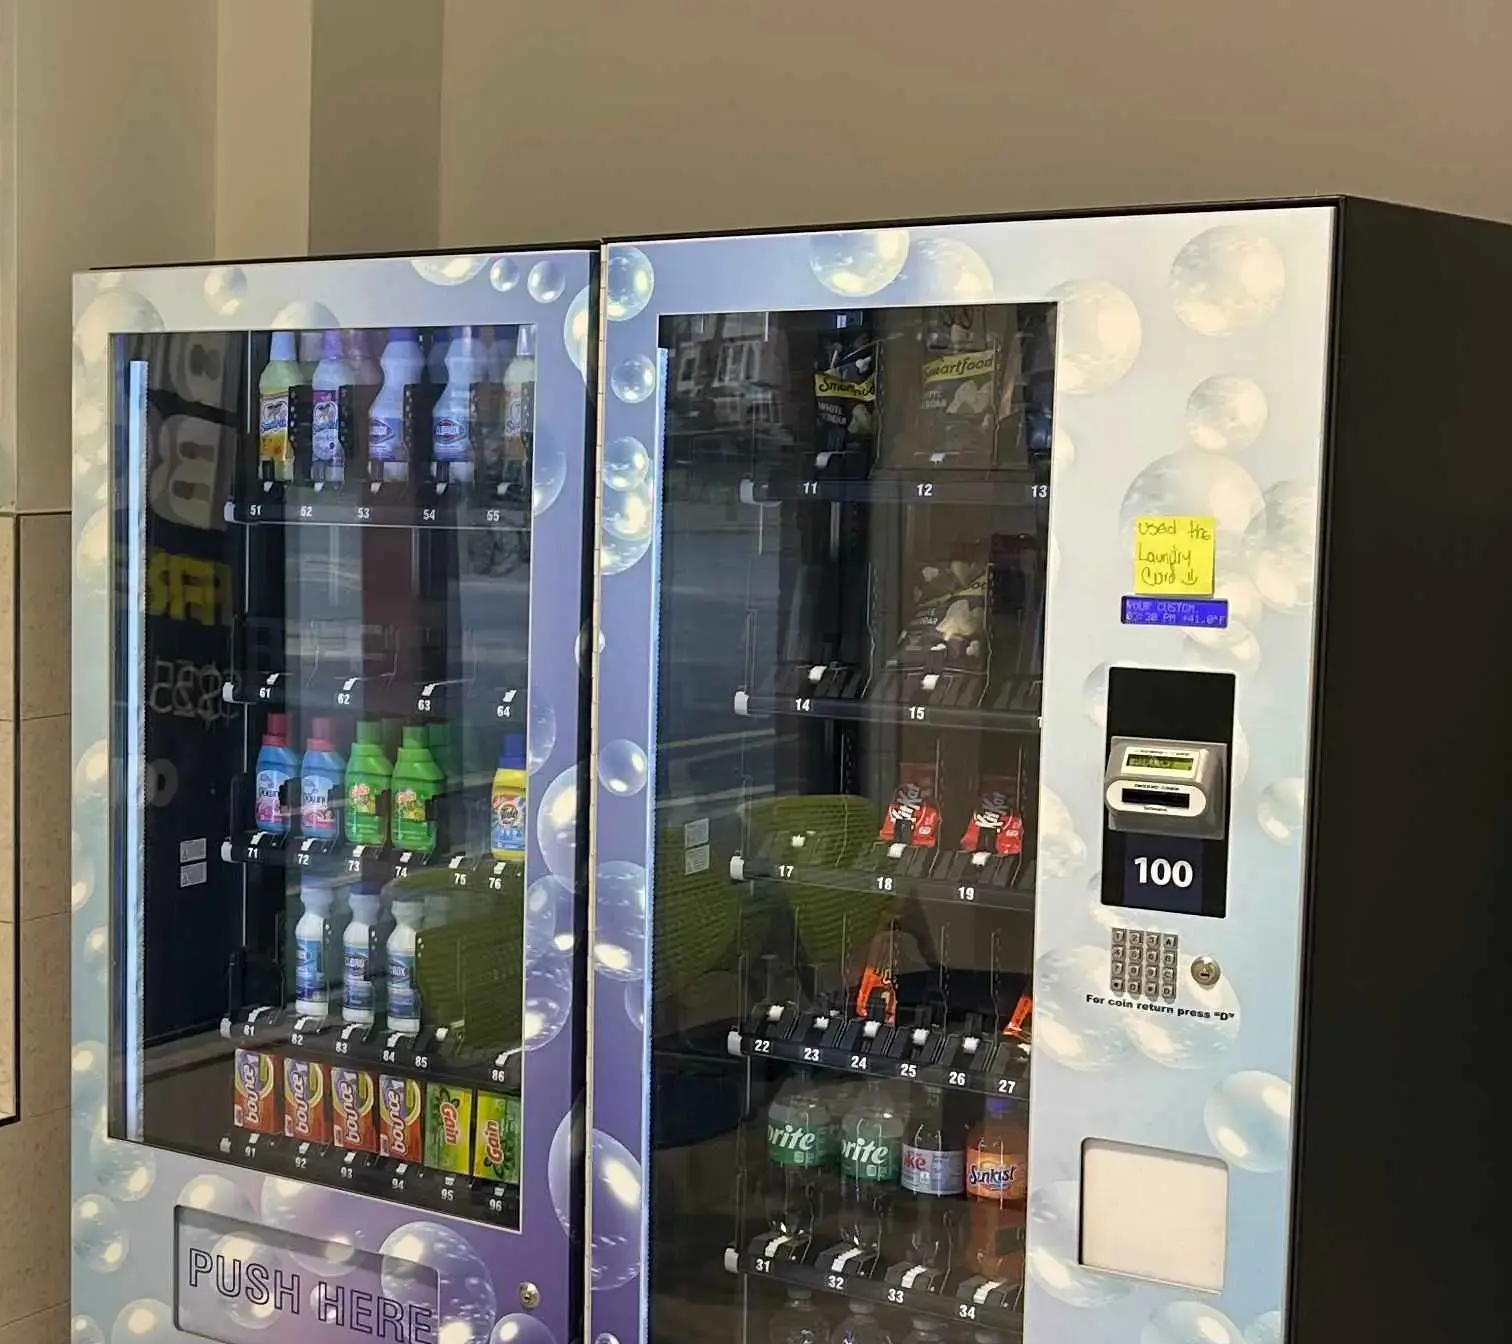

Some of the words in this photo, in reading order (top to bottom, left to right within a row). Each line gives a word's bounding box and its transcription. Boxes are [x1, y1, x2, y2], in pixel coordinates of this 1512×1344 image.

[803, 480, 818, 494] 11
[917, 483, 933, 497] 12
[1031, 485, 1048, 498] 13
[249, 505, 262, 516] 51
[300, 506, 313, 517] 52
[357, 508, 370, 519] 53
[423, 509, 436, 521] 54
[487, 510, 500, 522] 55
[259, 688, 271, 699] 61
[338, 693, 350, 705] 62
[418, 699, 431, 711] 63
[497, 706, 511, 717] 64
[795, 698, 811, 712] 14
[909, 706, 925, 720] 15
[248, 848, 258, 858] 71
[298, 854, 309, 865] 72
[348, 861, 360, 872] 73
[395, 866, 408, 878] 74
[778, 865, 794, 878] 17
[1134, 857, 1193, 888] 100
[454, 873, 467, 885] 75
[489, 877, 502, 889] 76
[876, 877, 893, 890] 18
[958, 886, 975, 900] 19
[1086, 994, 1105, 1004] For
[1108, 999, 1133, 1009] coin
[1137, 1003, 1174, 1014] return
[1177, 1007, 1211, 1019] press
[243, 1025, 255, 1037] 81
[291, 1034, 303, 1045] 82
[754, 1039, 770, 1052] 22
[336, 1042, 348, 1053] 83
[383, 1050, 395, 1062] 84
[804, 1048, 819, 1061] 23
[415, 1056, 428, 1068] 85
[851, 1056, 867, 1069] 24
[492, 1069, 505, 1082] 86
[901, 1063, 917, 1078] 25
[949, 1072, 966, 1086] 26
[999, 1079, 1016, 1093] 27
[243, 1064, 260, 1124] bounce
[292, 1071, 310, 1135] bounce
[340, 1082, 361, 1144] bounce
[387, 1088, 407, 1154] bounce
[440, 1103, 458, 1145] Gain
[486, 1120, 504, 1164] Gain
[768, 1124, 816, 1151] rite
[245, 1146, 256, 1157] 91
[841, 1137, 889, 1164] rite
[295, 1157, 307, 1169] 92
[340, 1167, 353, 1179] 93
[392, 1178, 404, 1190] 94
[441, 1188, 454, 1201] 95
[489, 1198, 502, 1211] 96
[755, 1258, 770, 1272] 31
[189, 1247, 300, 1315] PUSH
[828, 1275, 844, 1290] 32
[888, 1288, 904, 1303] 33
[959, 1305, 976, 1319] 34
